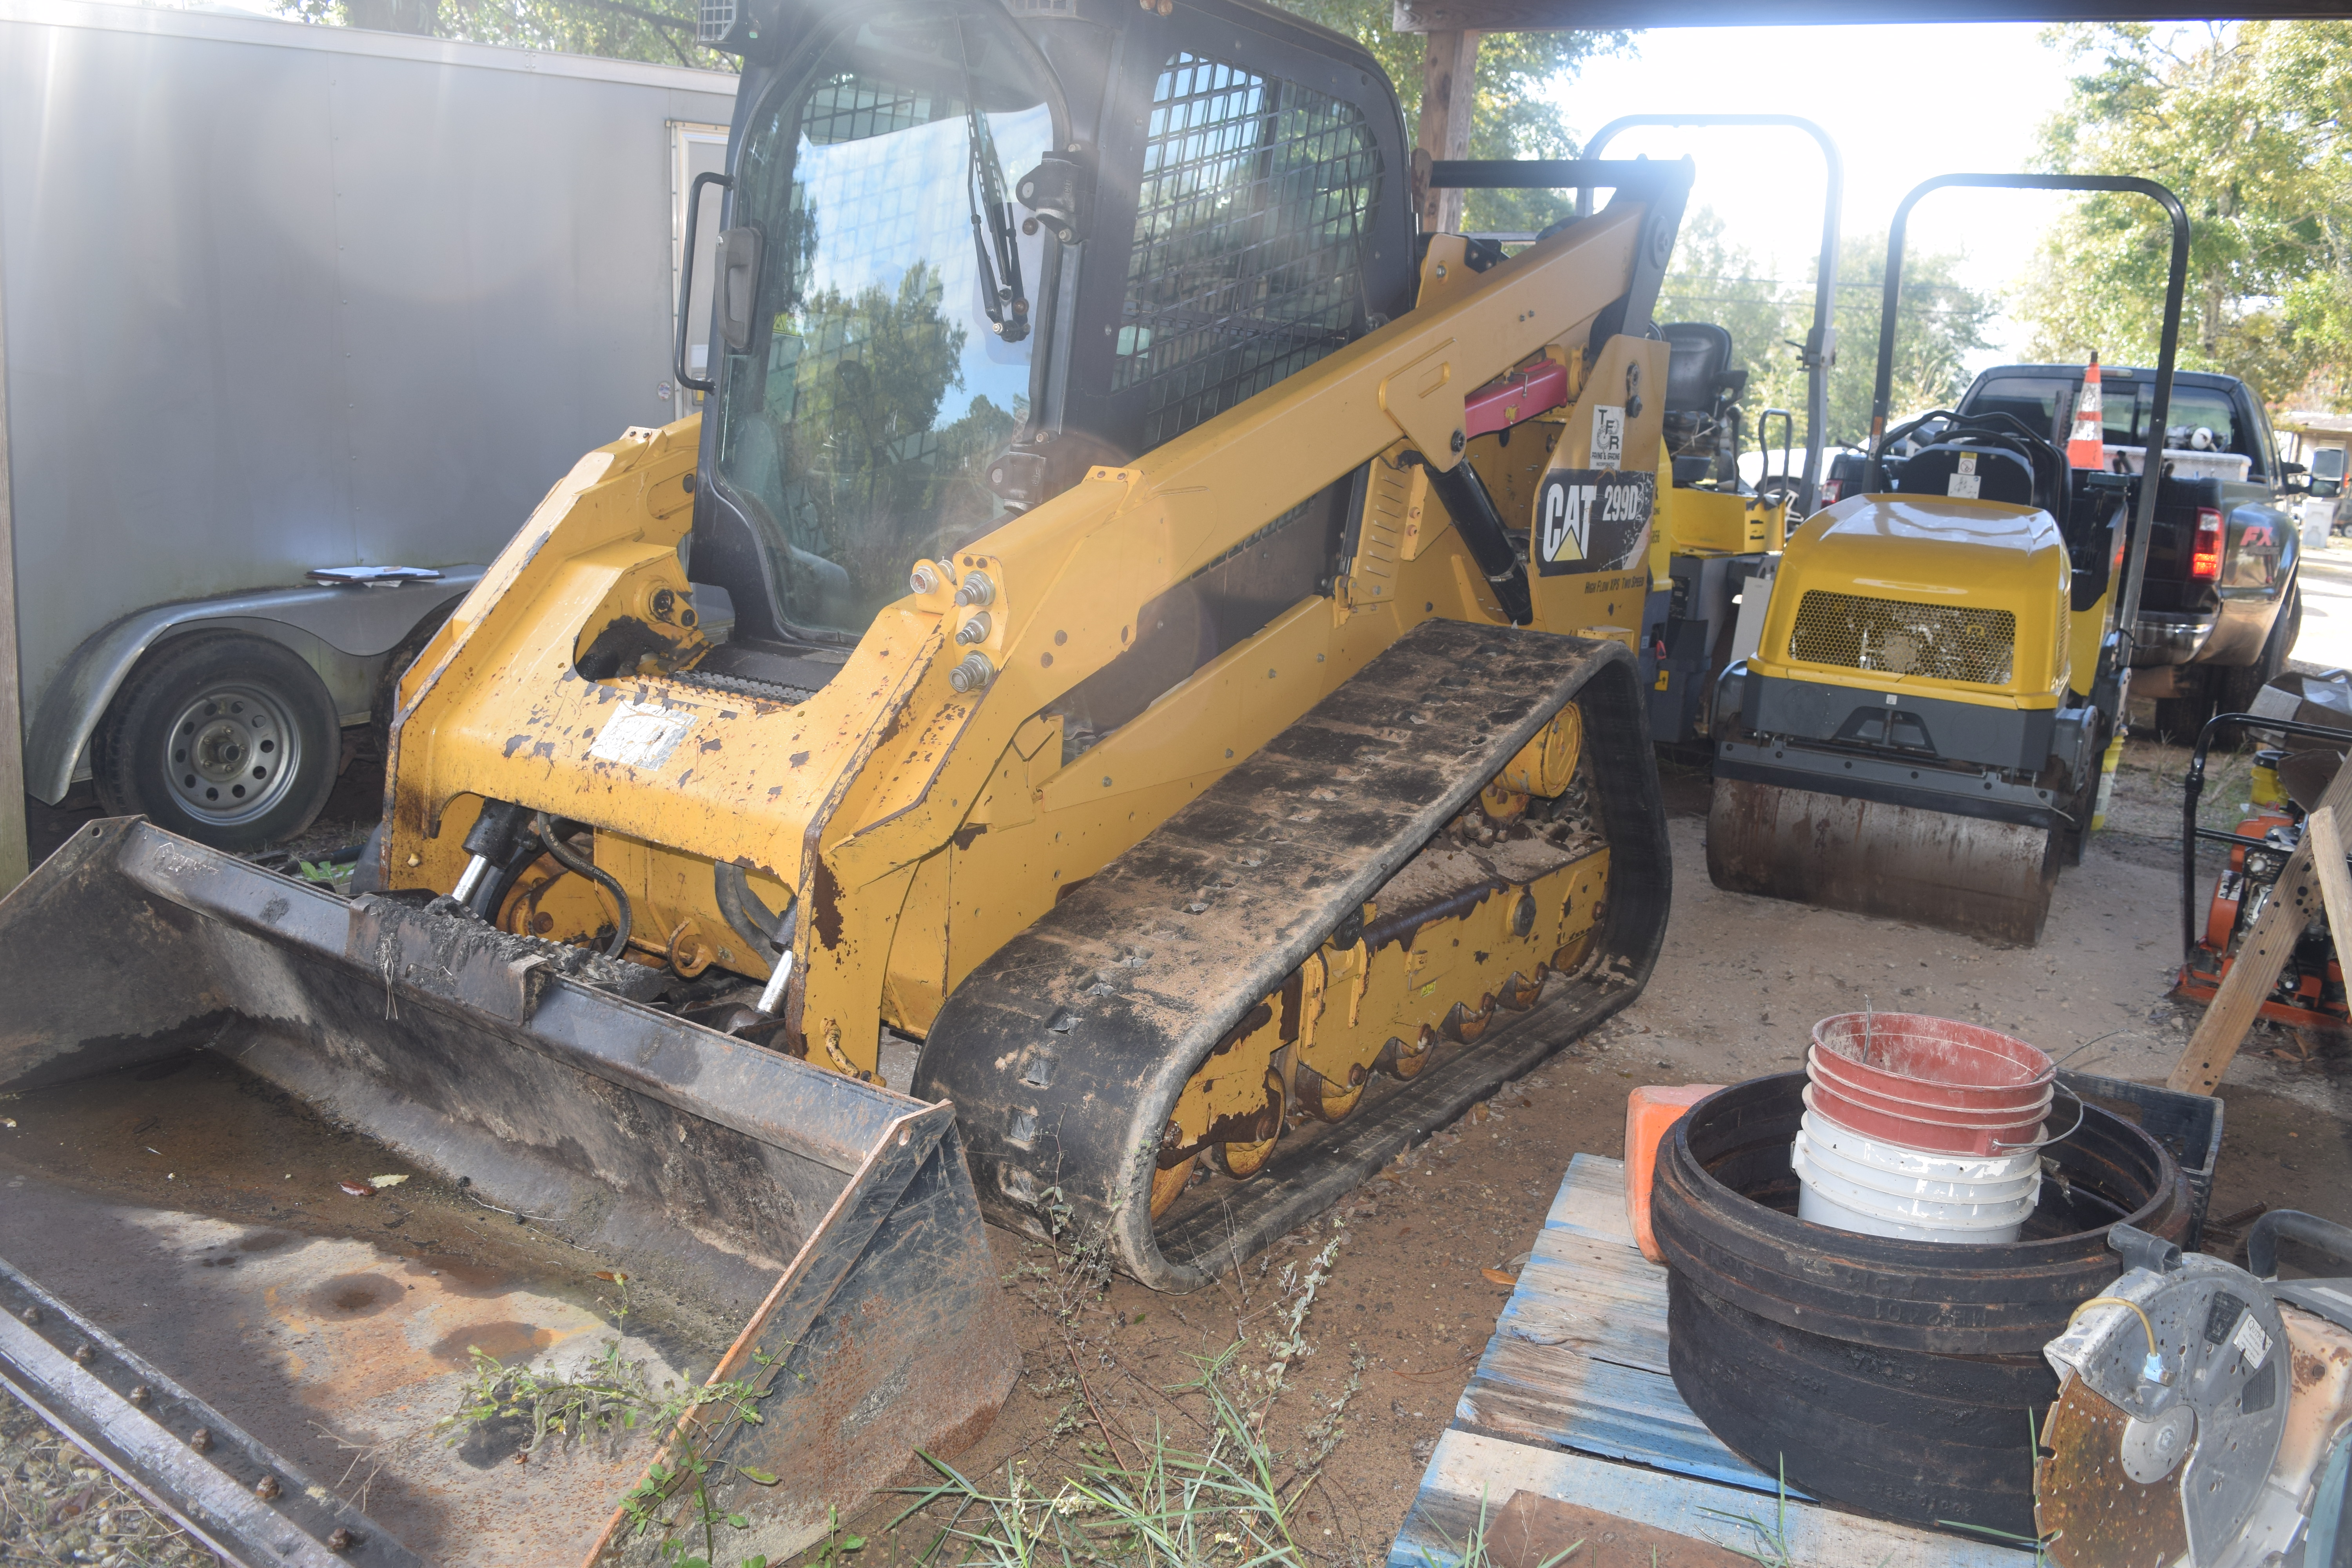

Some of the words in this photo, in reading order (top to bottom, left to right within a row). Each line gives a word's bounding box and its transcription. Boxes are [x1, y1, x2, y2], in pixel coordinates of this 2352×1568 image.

[1543, 483, 1597, 562] CAT
[1602, 485, 1639, 521] 299D
[1610, 578, 1620, 591] XPS
